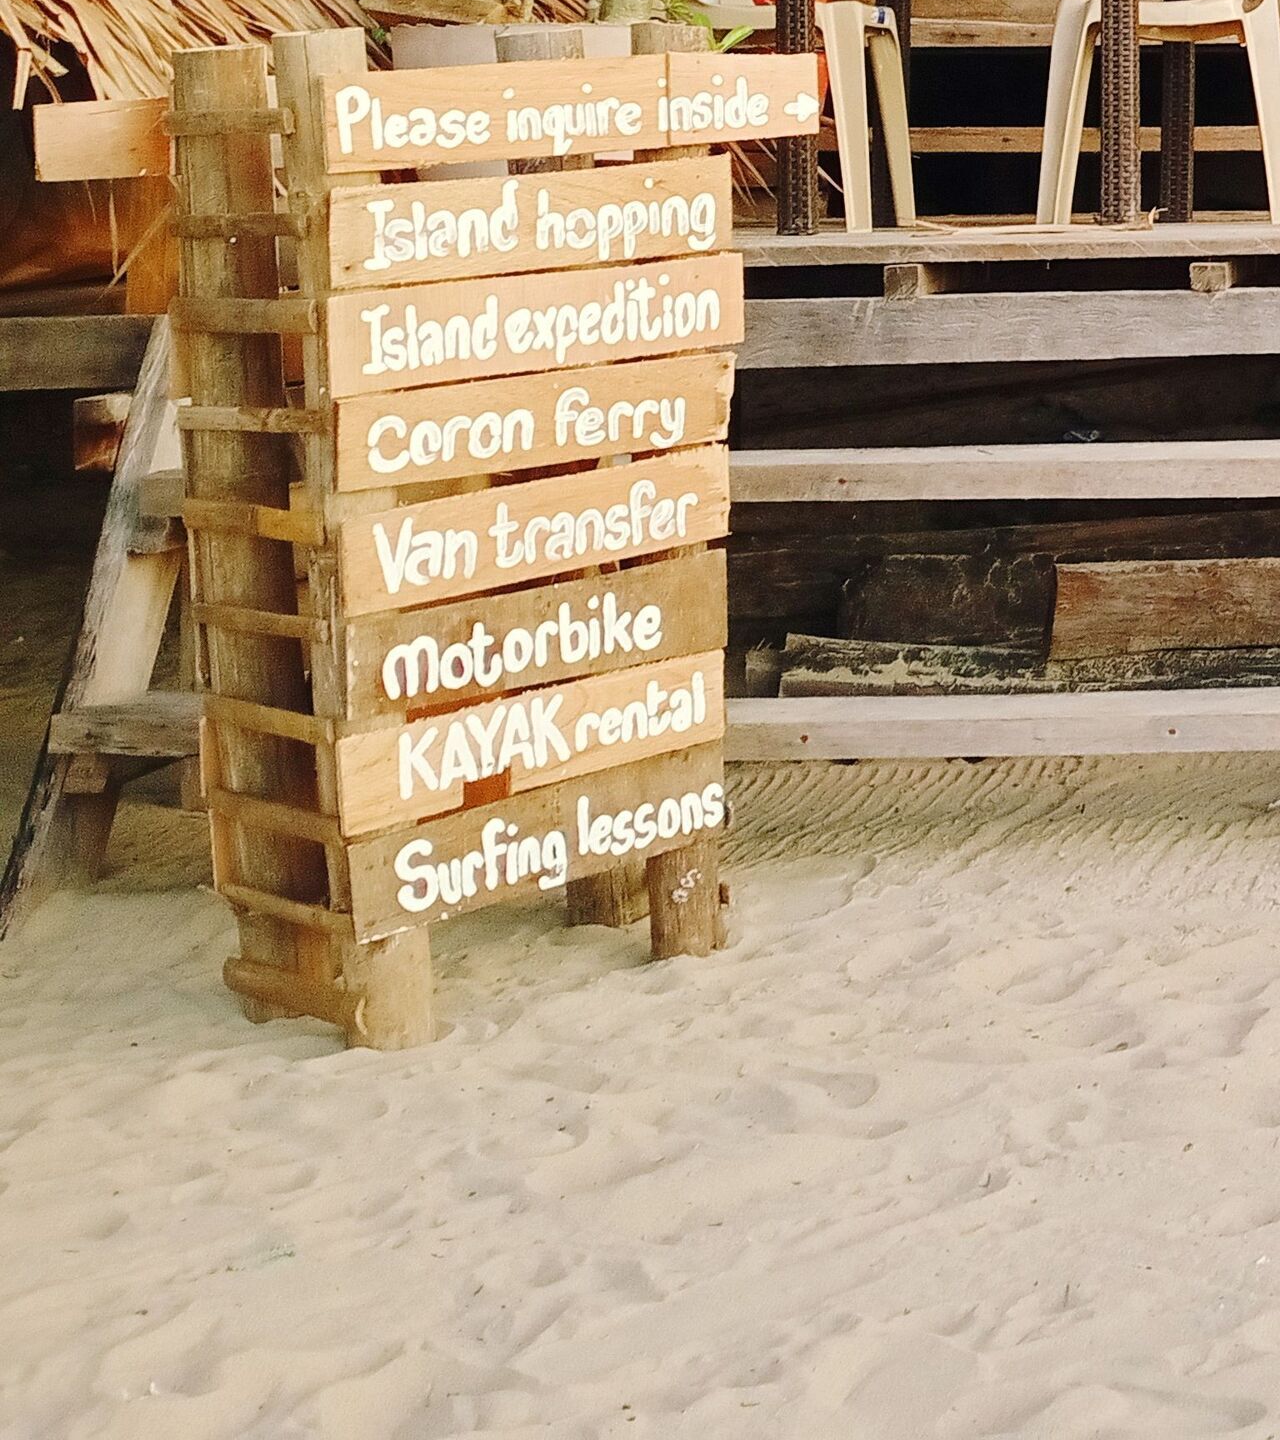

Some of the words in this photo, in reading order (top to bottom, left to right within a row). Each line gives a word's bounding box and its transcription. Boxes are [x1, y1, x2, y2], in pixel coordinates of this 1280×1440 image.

[335, 85, 490, 155] Please
[502, 83, 642, 155] inquire
[658, 74, 770, 133] inside
[363, 179, 519, 271] Island
[537, 178, 716, 261] hopping
[361, 294, 497, 376] Island
[504, 275, 720, 363] expedition
[366, 410, 535, 473] Coron
[554, 386, 686, 447] ferry
[373, 517, 478, 594] Van
[488, 479, 699, 568] transfer
[398, 693, 570, 800] KAYAK
[574, 672, 706, 753] rental
[394, 818, 566, 914] Surfing
[576, 781, 725, 859] lessons
